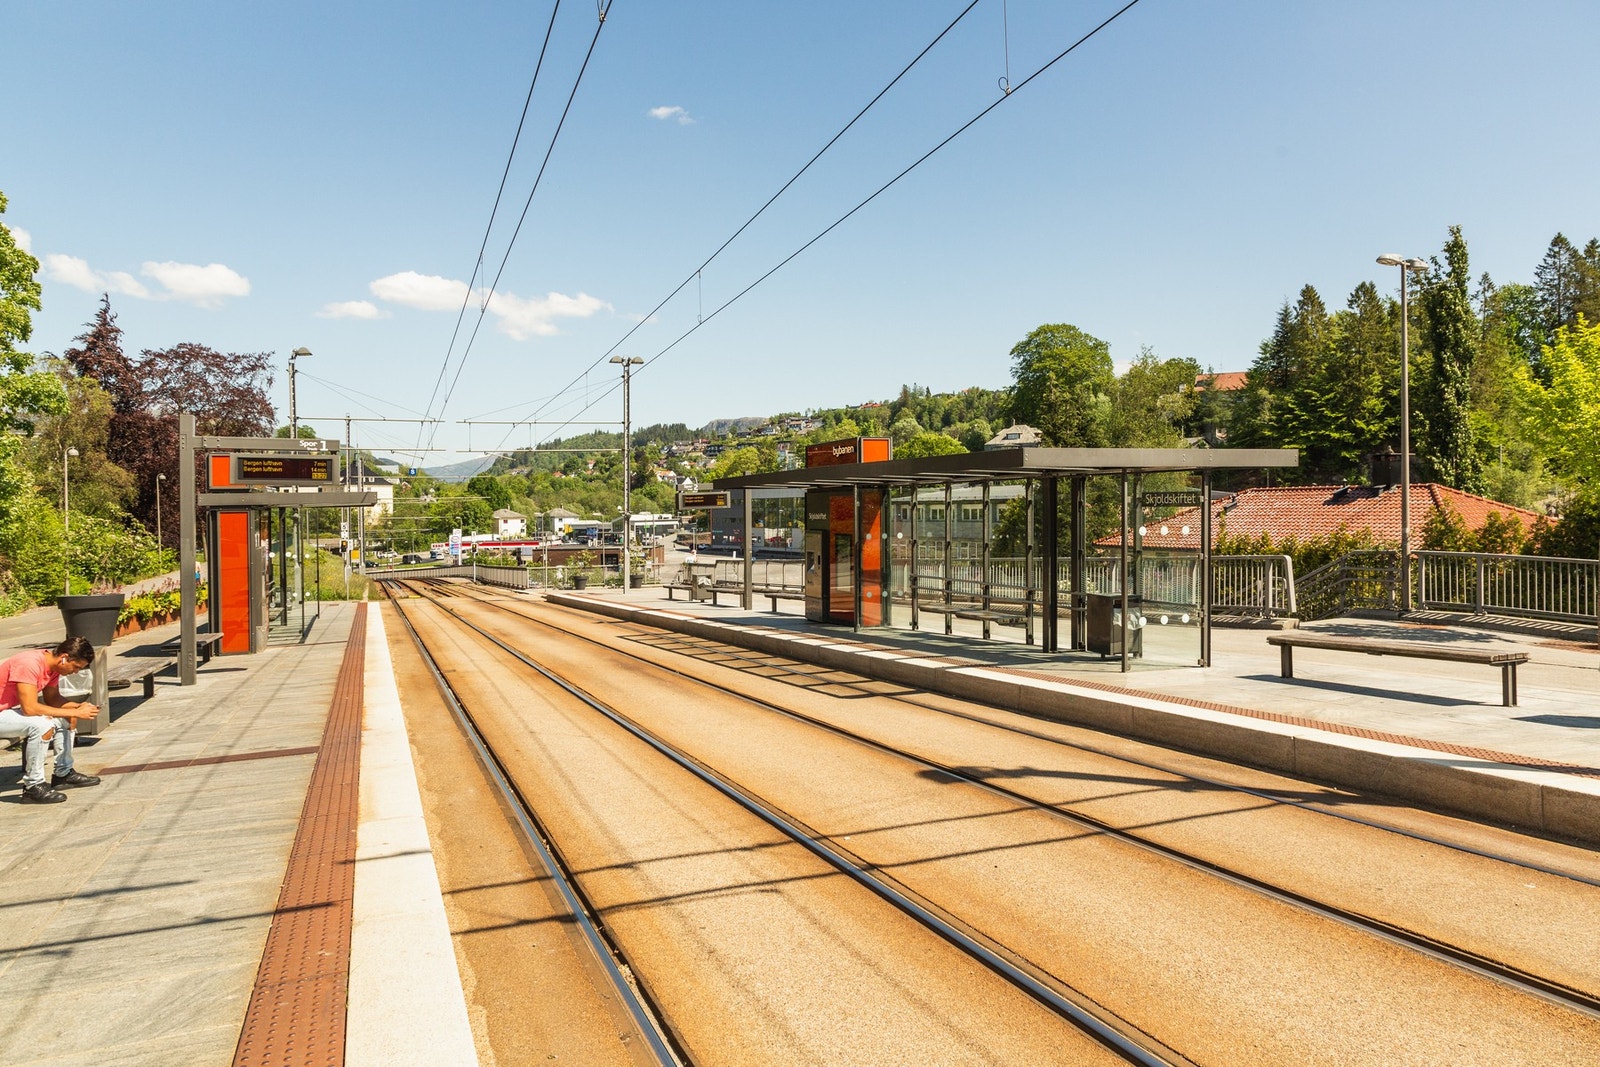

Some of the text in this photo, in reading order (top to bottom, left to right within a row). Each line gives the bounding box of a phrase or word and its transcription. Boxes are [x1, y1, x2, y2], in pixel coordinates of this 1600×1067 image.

[299, 440, 318, 448] Spor
[320, 440, 329, 451] 1
[833, 445, 855, 457] bybanen
[1145, 493, 1196, 506] Skjoldskiftet
